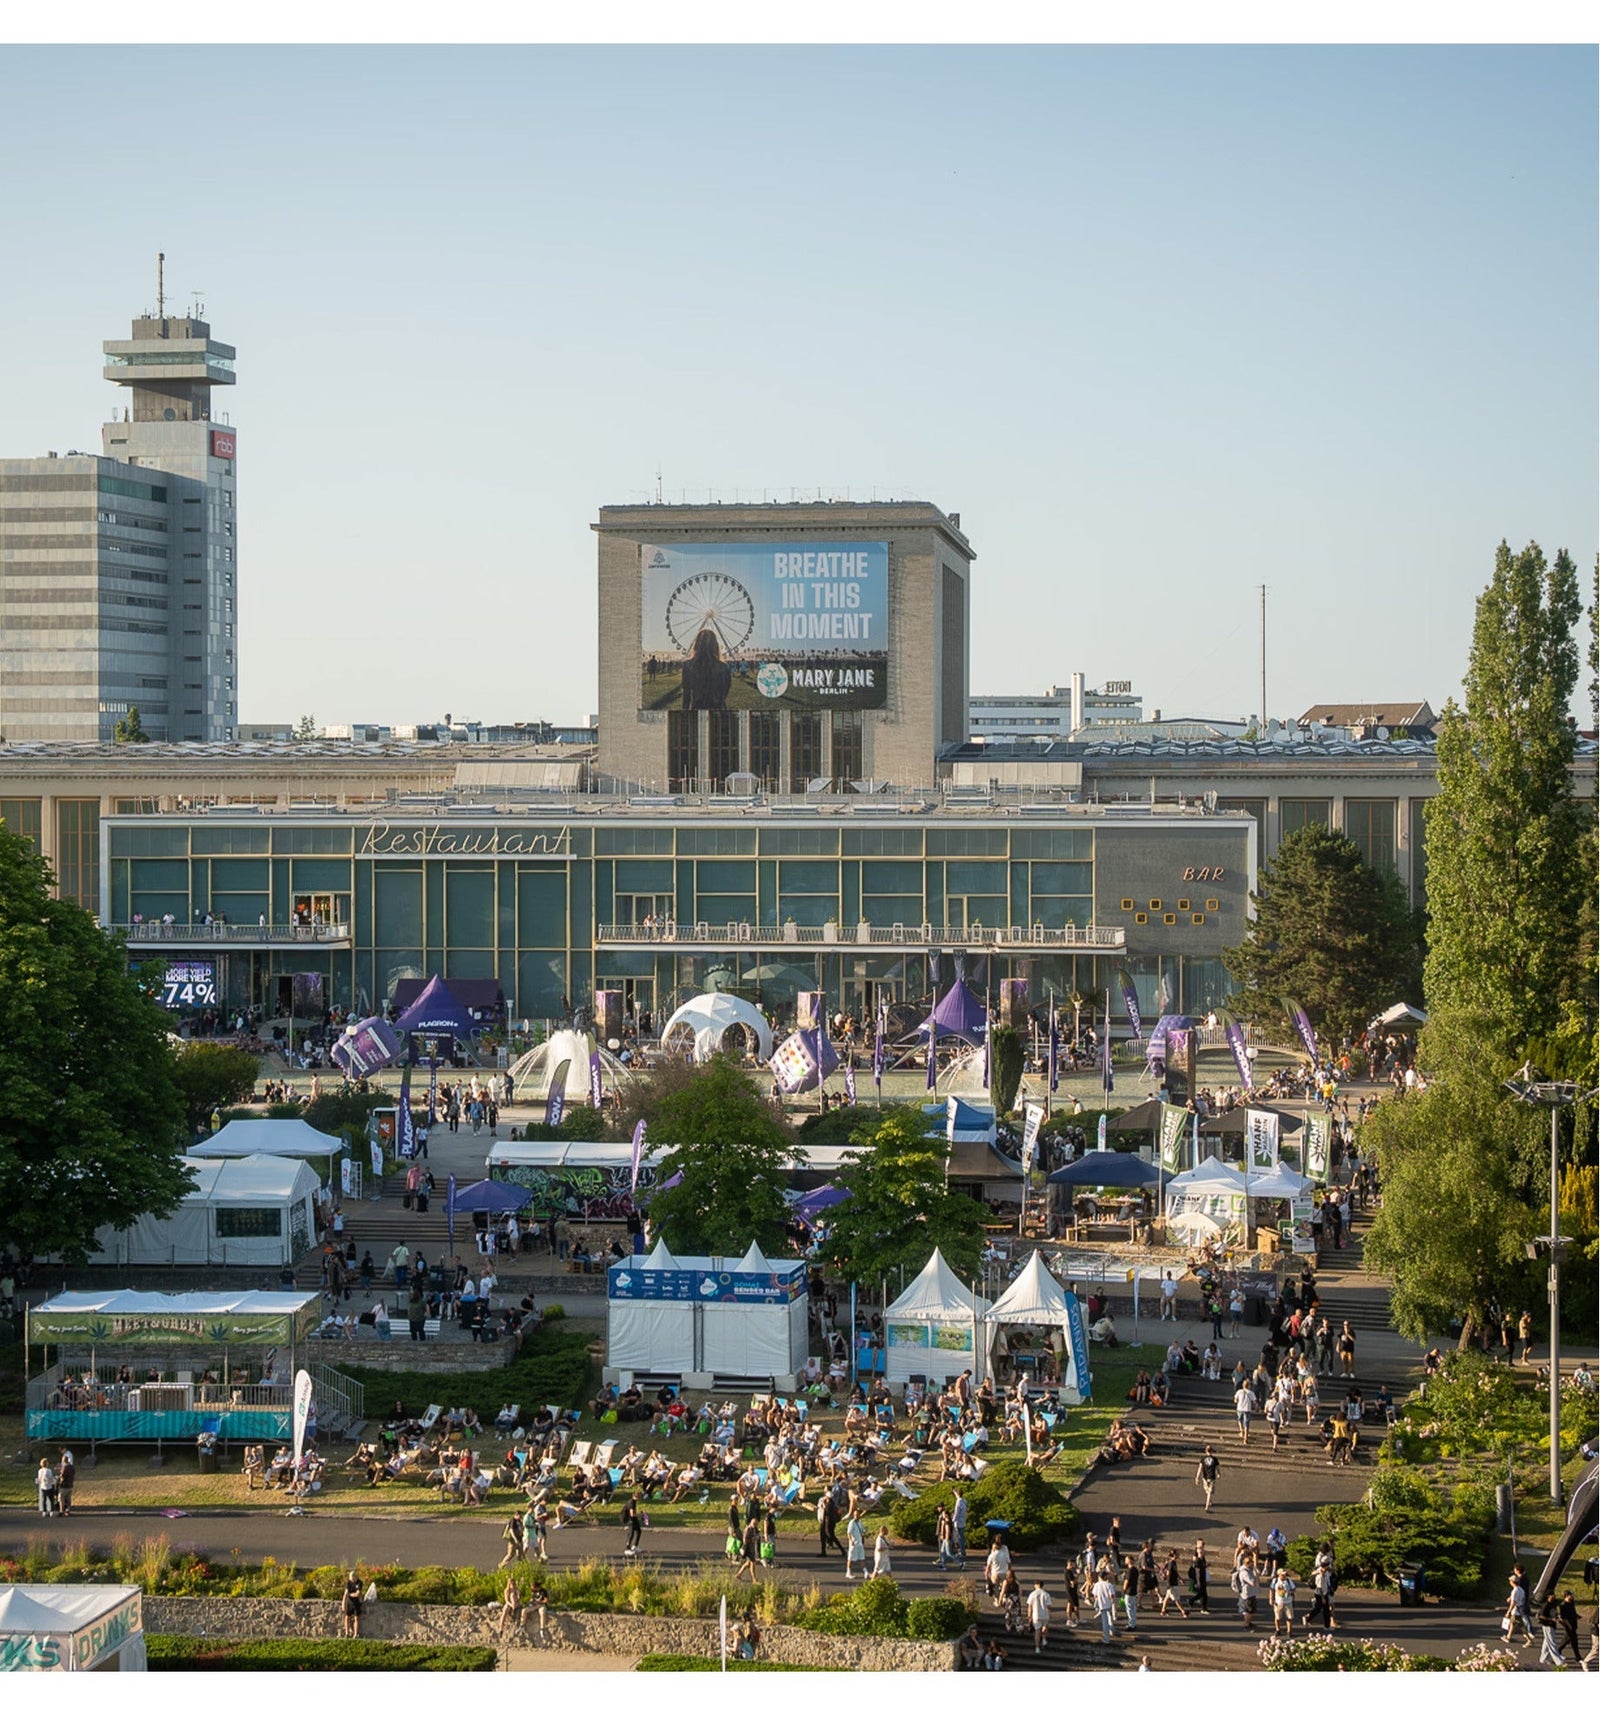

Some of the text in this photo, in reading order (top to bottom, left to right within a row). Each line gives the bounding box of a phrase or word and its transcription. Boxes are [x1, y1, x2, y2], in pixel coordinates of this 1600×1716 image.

[216, 438, 233, 454] rbb
[774, 552, 868, 579] BREATHE
[782, 583, 861, 609] IN THIS
[770, 613, 872, 639] MOMENT
[792, 669, 874, 688] MARY JANE
[361, 816, 573, 854] Restaurant
[1183, 866, 1224, 881] BAR
[418, 1020, 454, 1028] PLAGRON
[1254, 1117, 1262, 1150] HANF
[1071, 1304, 1088, 1389] PEDANIOS
[80, 1601, 138, 1663] DRINKS
